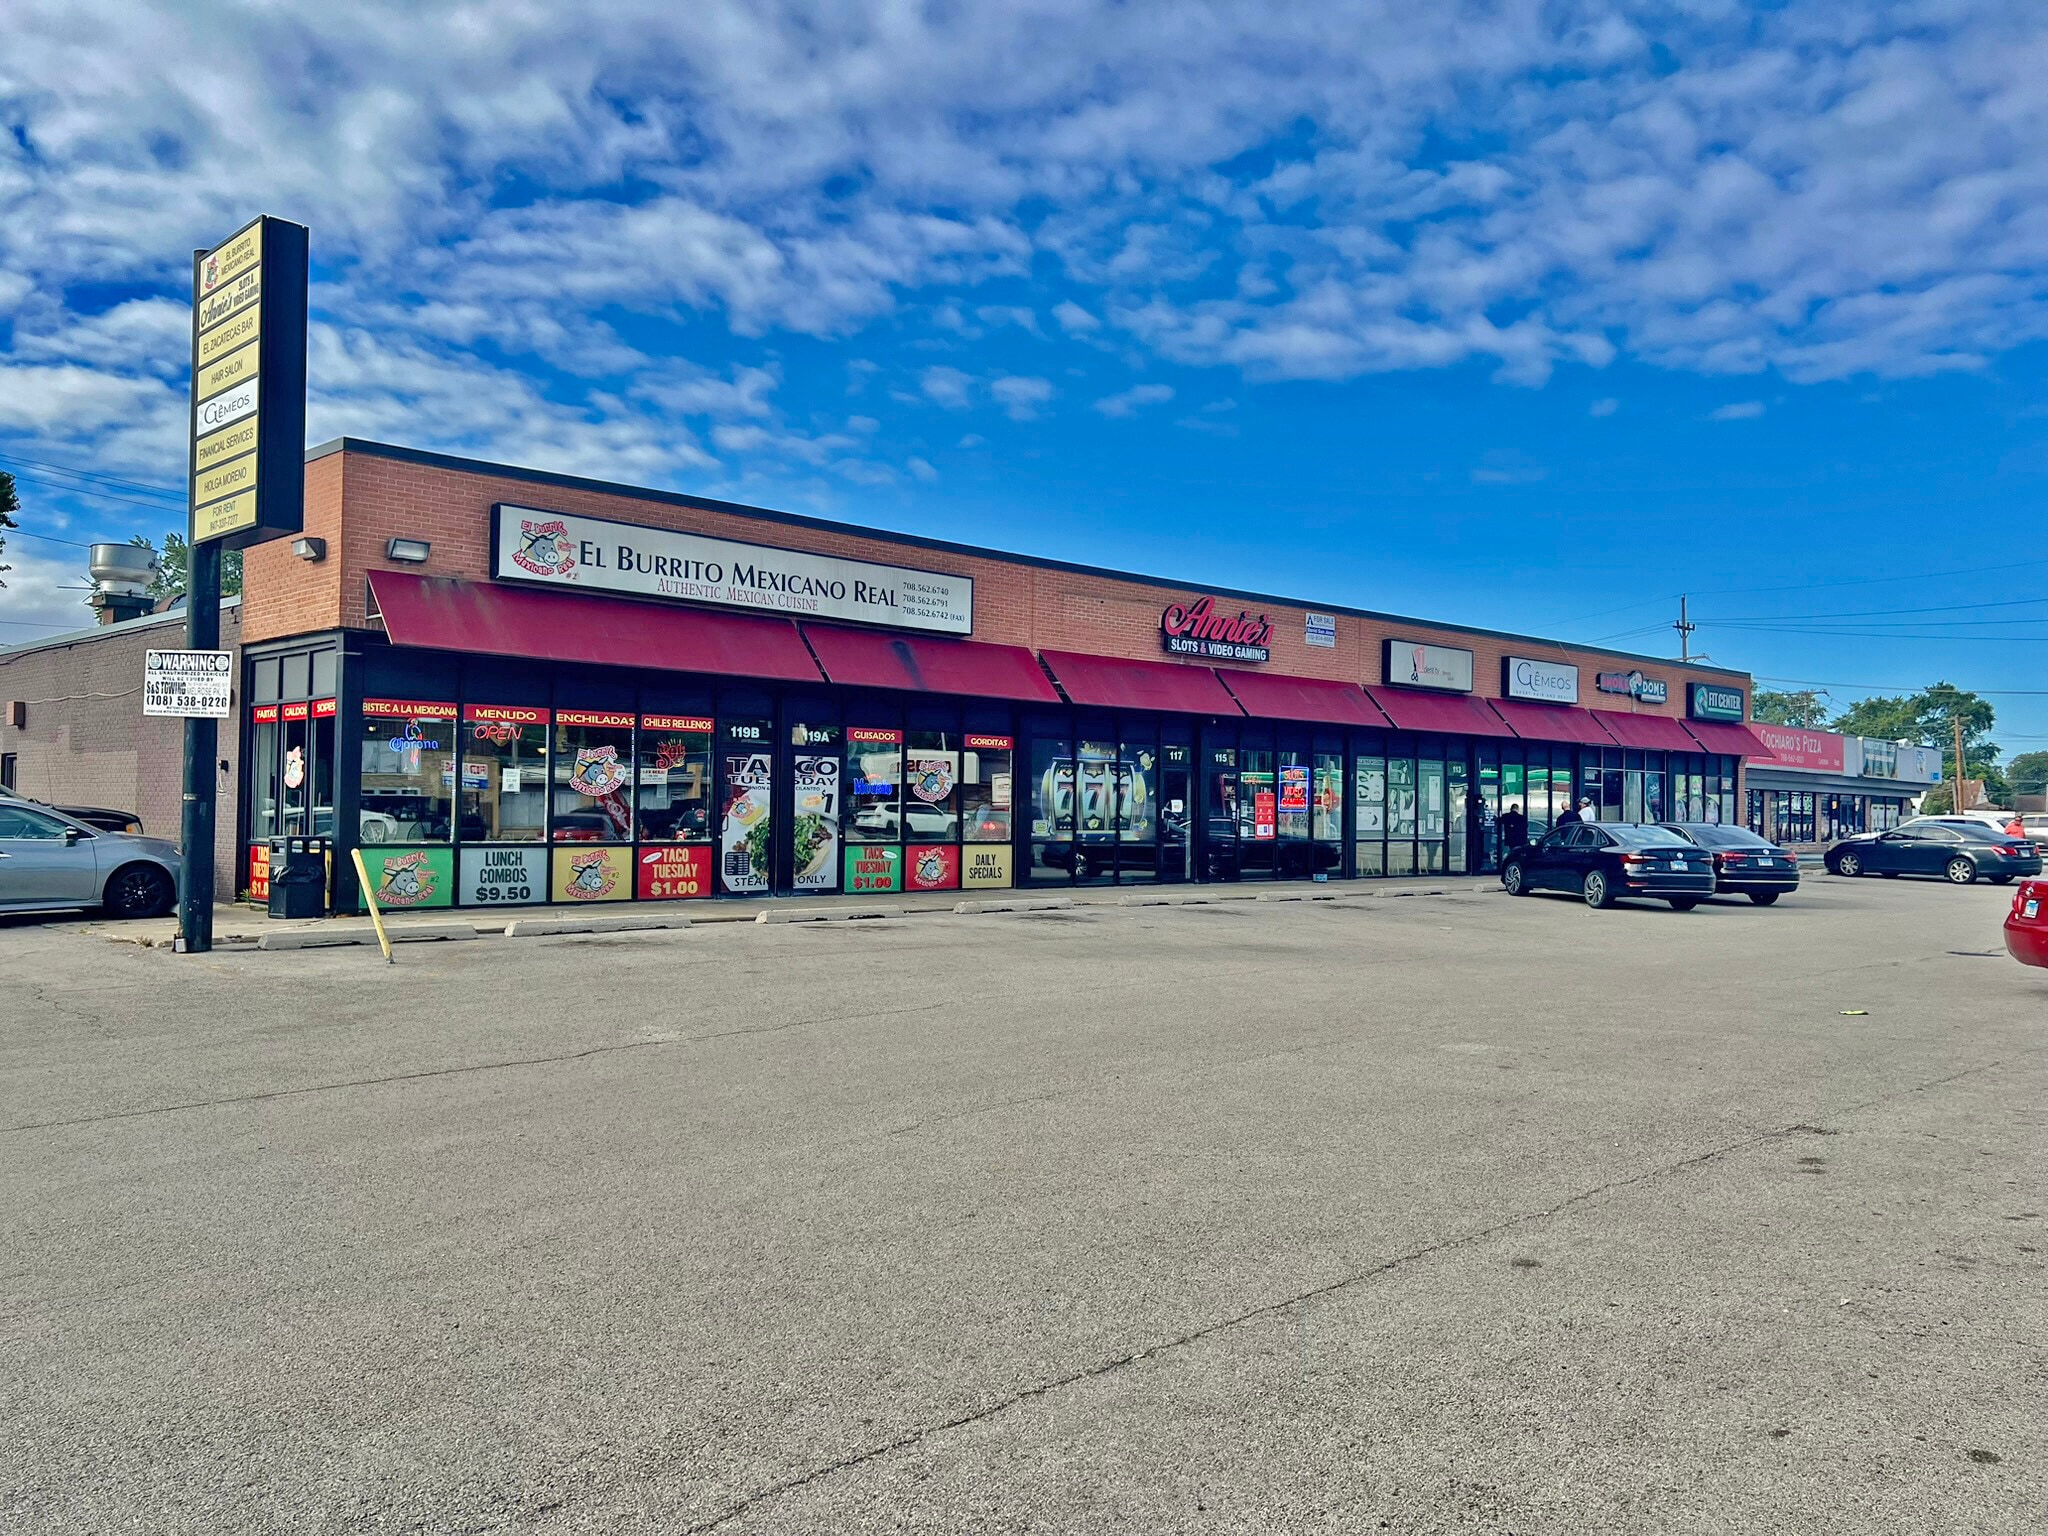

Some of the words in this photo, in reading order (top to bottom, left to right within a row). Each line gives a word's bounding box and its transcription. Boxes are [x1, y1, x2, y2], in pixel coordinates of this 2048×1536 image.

[231, 238, 251, 257] BURRITO
[221, 254, 243, 276] MEXICANO
[243, 247, 255, 262] REAL
[203, 343, 210, 354] EL
[210, 324, 241, 351] ZACATECAS
[241, 317, 253, 334] BAR
[211, 369, 224, 385] HAIR
[224, 358, 243, 378] SALON
[199, 440, 226, 460] FINANCIAL
[226, 427, 254, 449] SERVICES
[203, 476, 223, 493] HOLGA
[222, 466, 247, 488] MORENO
[212, 505, 222, 518] FOR
[223, 500, 236, 514] RENT
[512, 549, 555, 576] Mexicano
[579, 540, 607, 568] EL
[617, 545, 723, 583] BURRITO
[731, 562, 846, 600] MEXICANO
[854, 580, 898, 607] REAL
[657, 577, 721, 599] AUTHENTIC
[726, 586, 775, 606] MEXICAN
[777, 593, 819, 612] CUISINE
[902, 581, 949, 596] 708.562.6740
[902, 593, 949, 608] 708.562.6791
[902, 606, 949, 620] 708.562.6742
[1313, 615, 1323, 623] FOR
[1162, 596, 1274, 647] Annie's
[1171, 638, 1198, 653] SLOTS
[1200, 642, 1207, 654] &
[1208, 642, 1234, 657] VIDEO
[1234, 646, 1267, 661] GAMING
[161, 653, 216, 671] WARNING
[146, 681, 160, 695] S&S
[161, 681, 187, 695] TOWING
[1642, 680, 1665, 696] DOME
[146, 695, 173, 706] (708)
[316, 701, 336, 713] SOPES
[1708, 692, 1718, 707] FIT
[1718, 693, 1741, 710] CENTER
[256, 708, 277, 719] FAJITAS
[284, 705, 308, 717] CALDOS
[362, 702, 391, 713] BISTEC
[392, 704, 400, 713] A
[400, 704, 413, 714] LA
[413, 705, 458, 716] MEXICANA
[475, 709, 537, 721] MENUDO
[556, 713, 635, 726] ENCHILADAS
[643, 717, 671, 729] CHILES
[672, 719, 712, 730] RELLENOS
[474, 725, 524, 740] OPEN
[731, 726, 760, 738] 119B
[804, 731, 830, 743] 119A
[853, 730, 896, 741] GUISADOS
[389, 736, 439, 753] Corona
[970, 737, 1008, 747] GORDITAS
[1760, 729, 1801, 752] COCHIARO'S
[1802, 735, 1822, 753] PIZZA
[1169, 751, 1183, 761] 117
[1214, 753, 1228, 763] 115
[1085, 782, 1103, 810] 7
[1283, 785, 1304, 796] VIDEO
[485, 851, 523, 867] LUNCH
[662, 848, 689, 863] TACO
[863, 846, 886, 860] TACO
[975, 854, 996, 866] DAILY
[652, 863, 698, 879] TUESDAY
[855, 861, 892, 874] TUESDAY
[969, 867, 1003, 880] SPECIALS
[480, 868, 527, 883] COMBOS
[797, 875, 826, 884] ONLY
[853, 876, 892, 889] $1.00
[251, 879, 269, 896] $1.0
[475, 886, 531, 903] $9.50
[650, 881, 698, 897] $1.00
[375, 888, 416, 905] Mexicano
